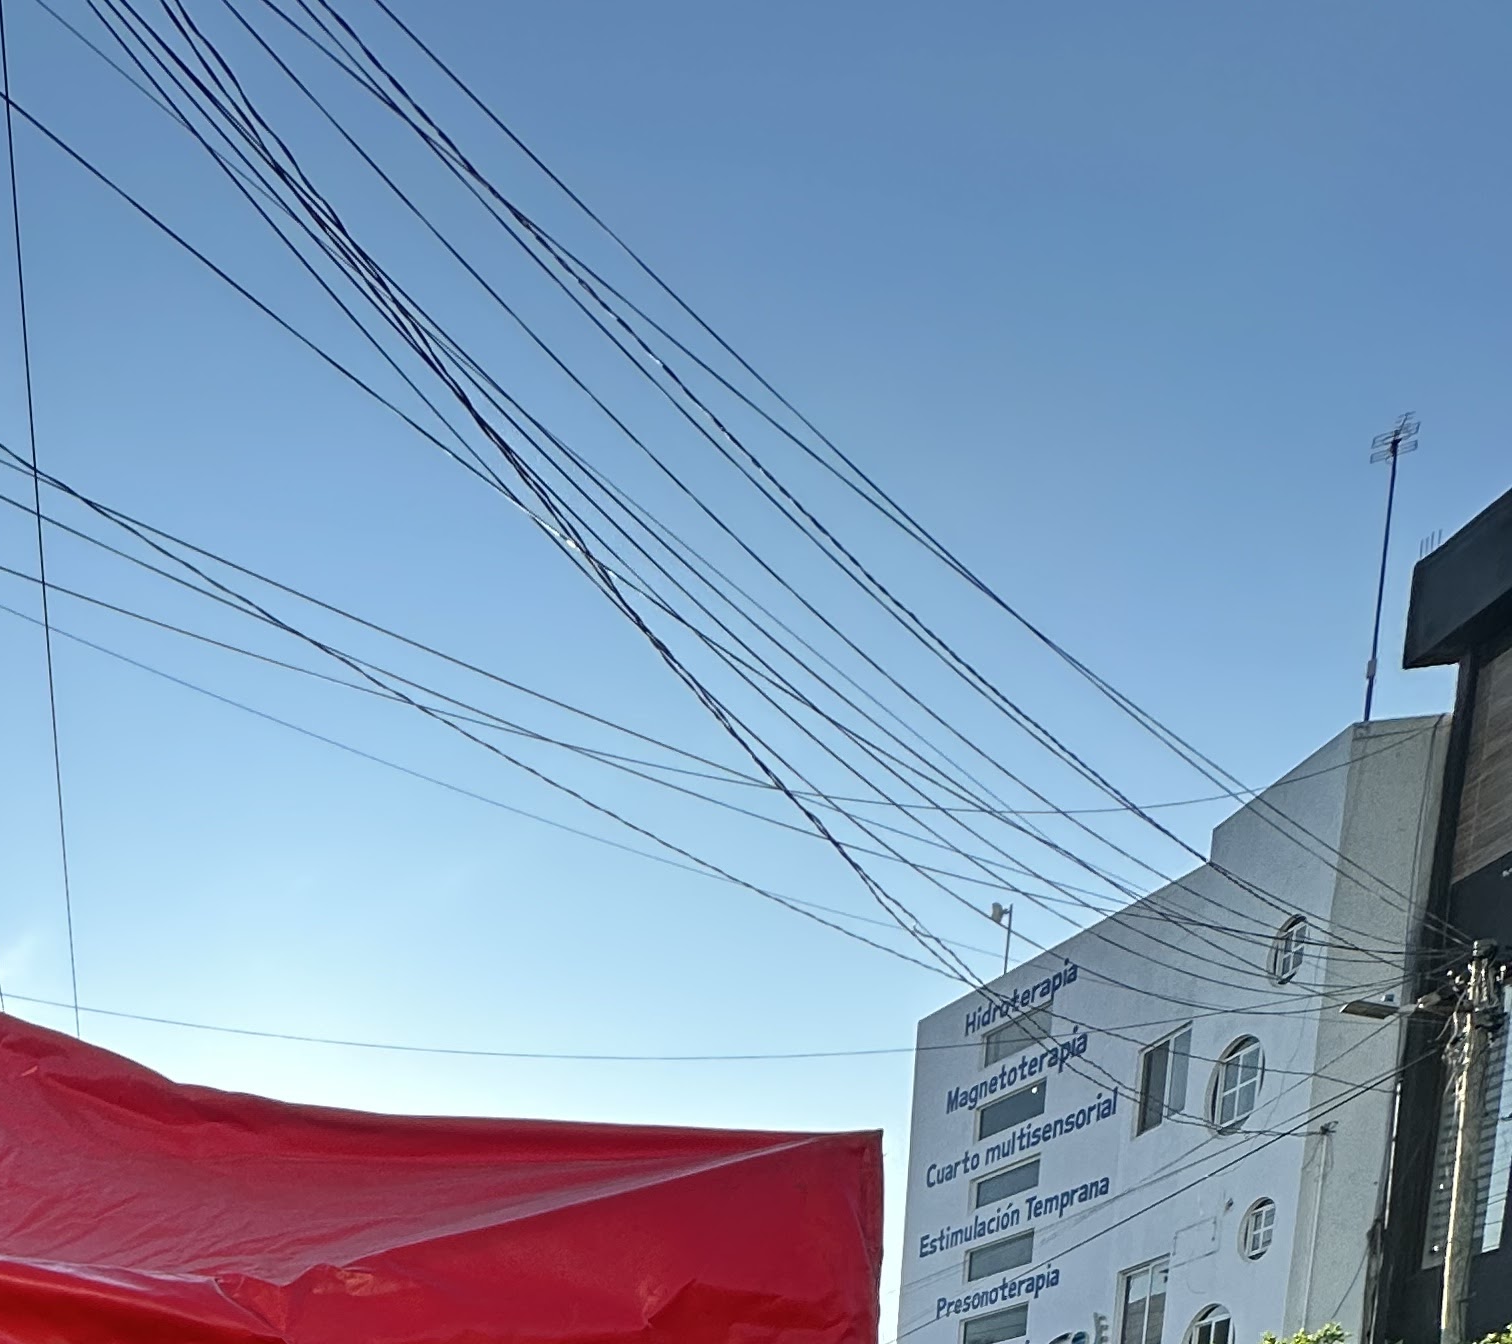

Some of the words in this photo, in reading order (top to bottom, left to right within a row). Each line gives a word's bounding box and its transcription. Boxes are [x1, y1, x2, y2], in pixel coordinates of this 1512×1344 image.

[964, 958, 1079, 1036] Hidroterapia
[946, 1025, 1088, 1114] Magnetoterapia
[926, 1150, 980, 1188] Cuarto
[984, 1086, 1119, 1166] multisensorial
[919, 1203, 1020, 1258] Estimulación
[1025, 1176, 1110, 1221] Temprana
[936, 1263, 1060, 1320] Presonoterapia
